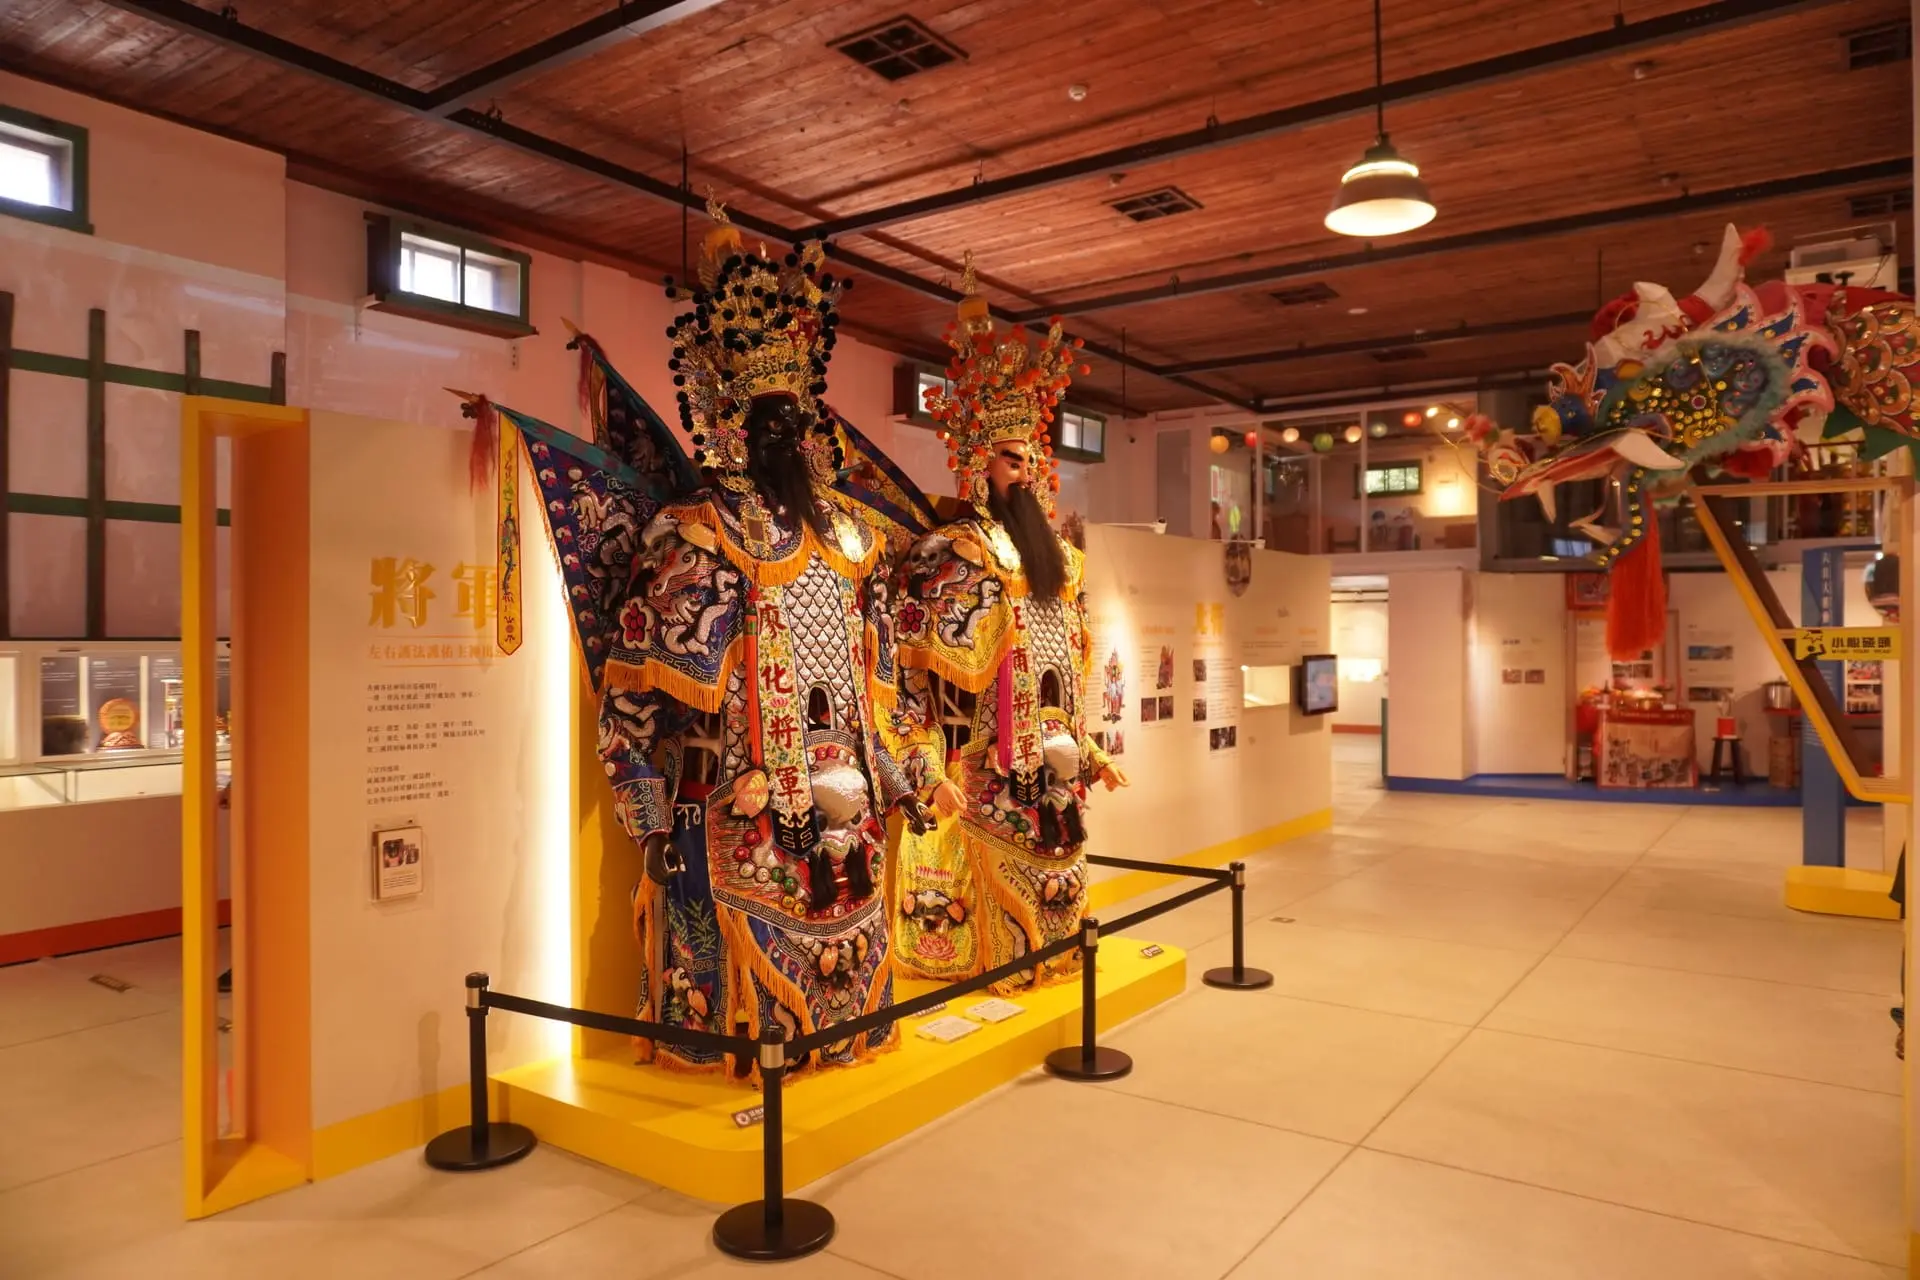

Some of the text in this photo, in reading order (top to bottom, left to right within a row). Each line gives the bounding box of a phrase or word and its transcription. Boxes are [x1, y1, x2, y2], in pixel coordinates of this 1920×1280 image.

[368, 557, 497, 630] 將軍
[760, 603, 804, 805] 廖化將軍
